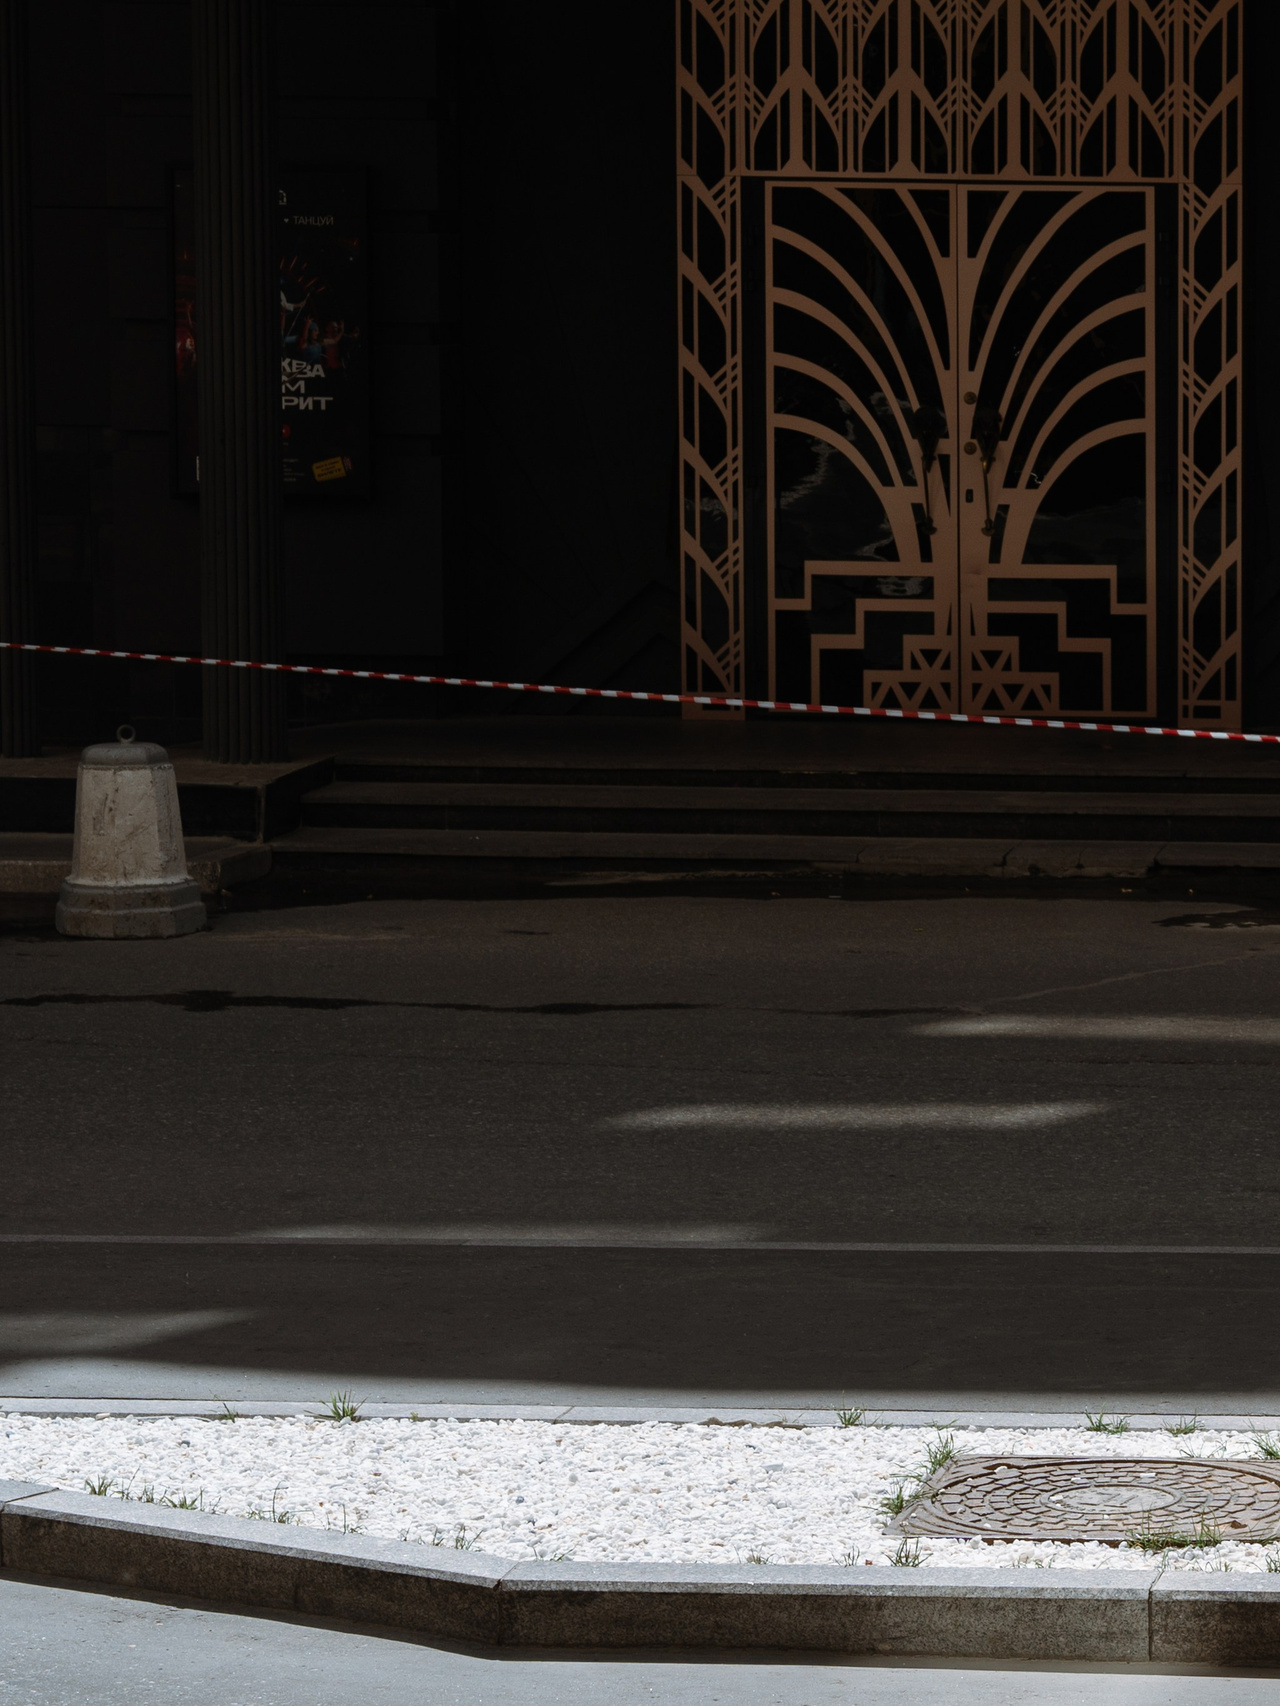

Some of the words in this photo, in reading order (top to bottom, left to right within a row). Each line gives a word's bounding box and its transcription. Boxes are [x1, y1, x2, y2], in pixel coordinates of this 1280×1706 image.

[293, 214, 334, 227] ТАНЦУЙ
[281, 357, 326, 378] КВА
[282, 396, 334, 411] РИТ
